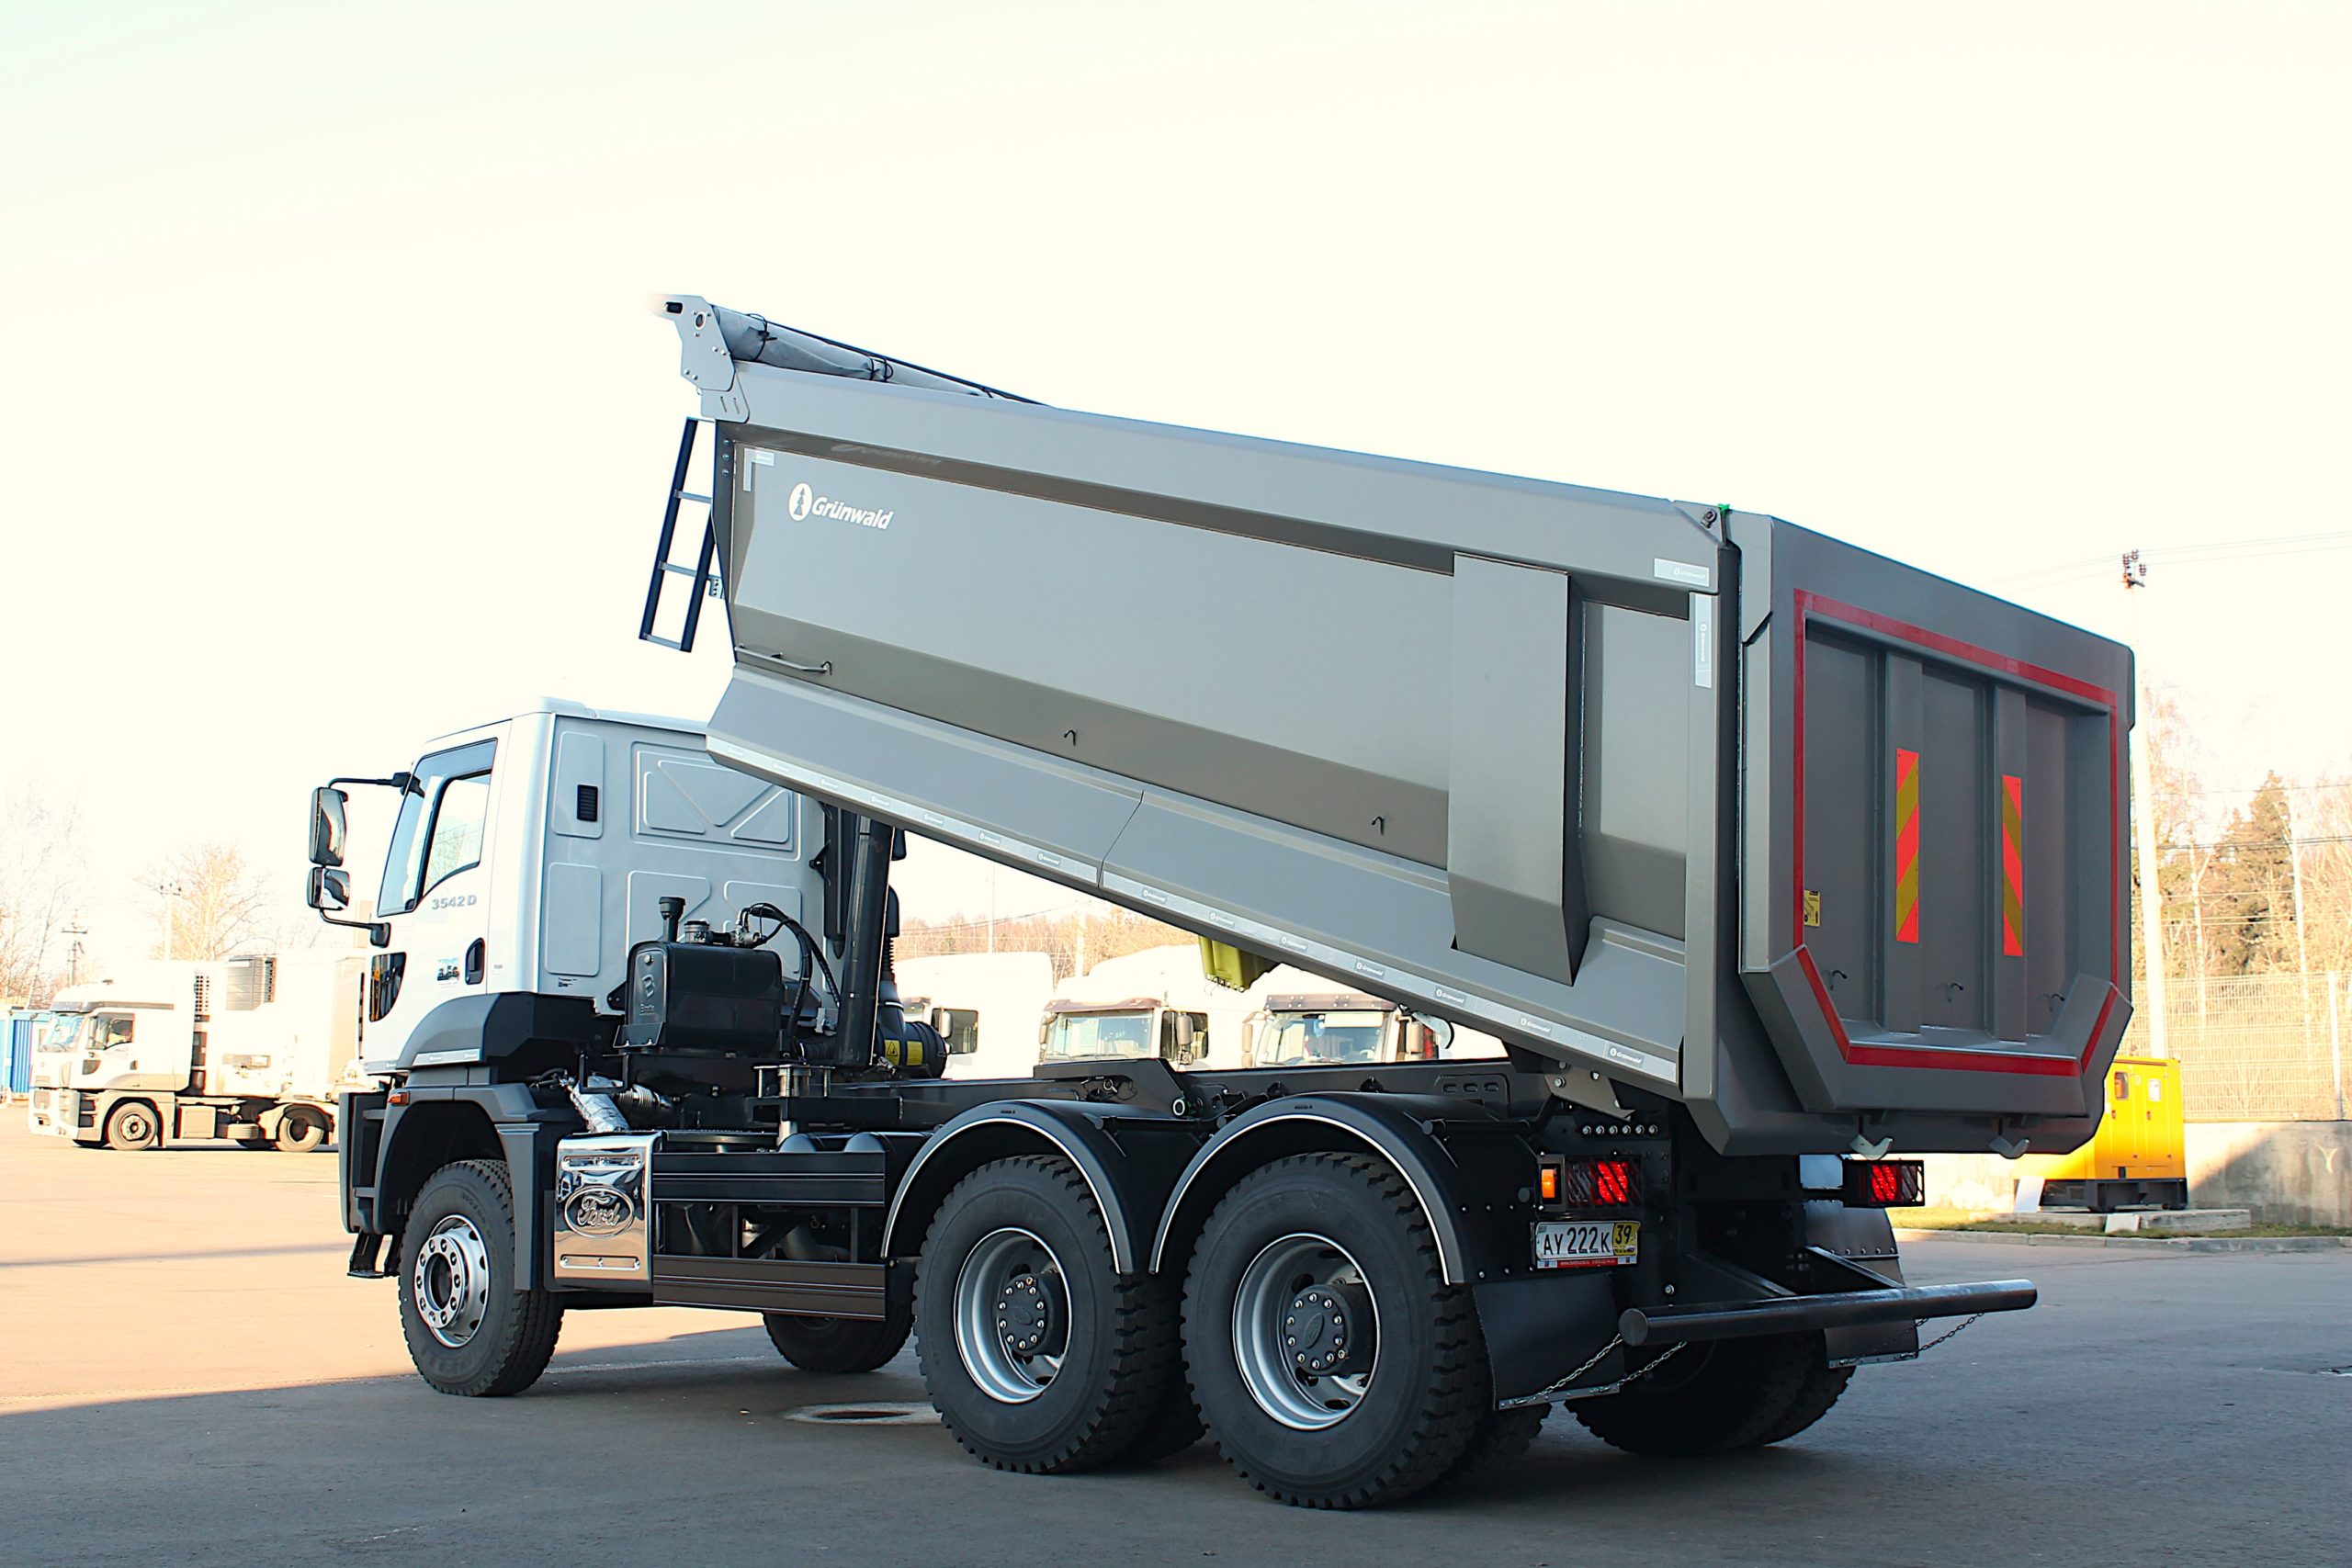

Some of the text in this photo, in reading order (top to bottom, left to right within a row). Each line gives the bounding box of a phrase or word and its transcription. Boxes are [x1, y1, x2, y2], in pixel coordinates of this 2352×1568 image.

[811, 496, 894, 530] Grünwald
[576, 1194, 622, 1227] Ford
[1615, 1224, 1633, 1245] 39
